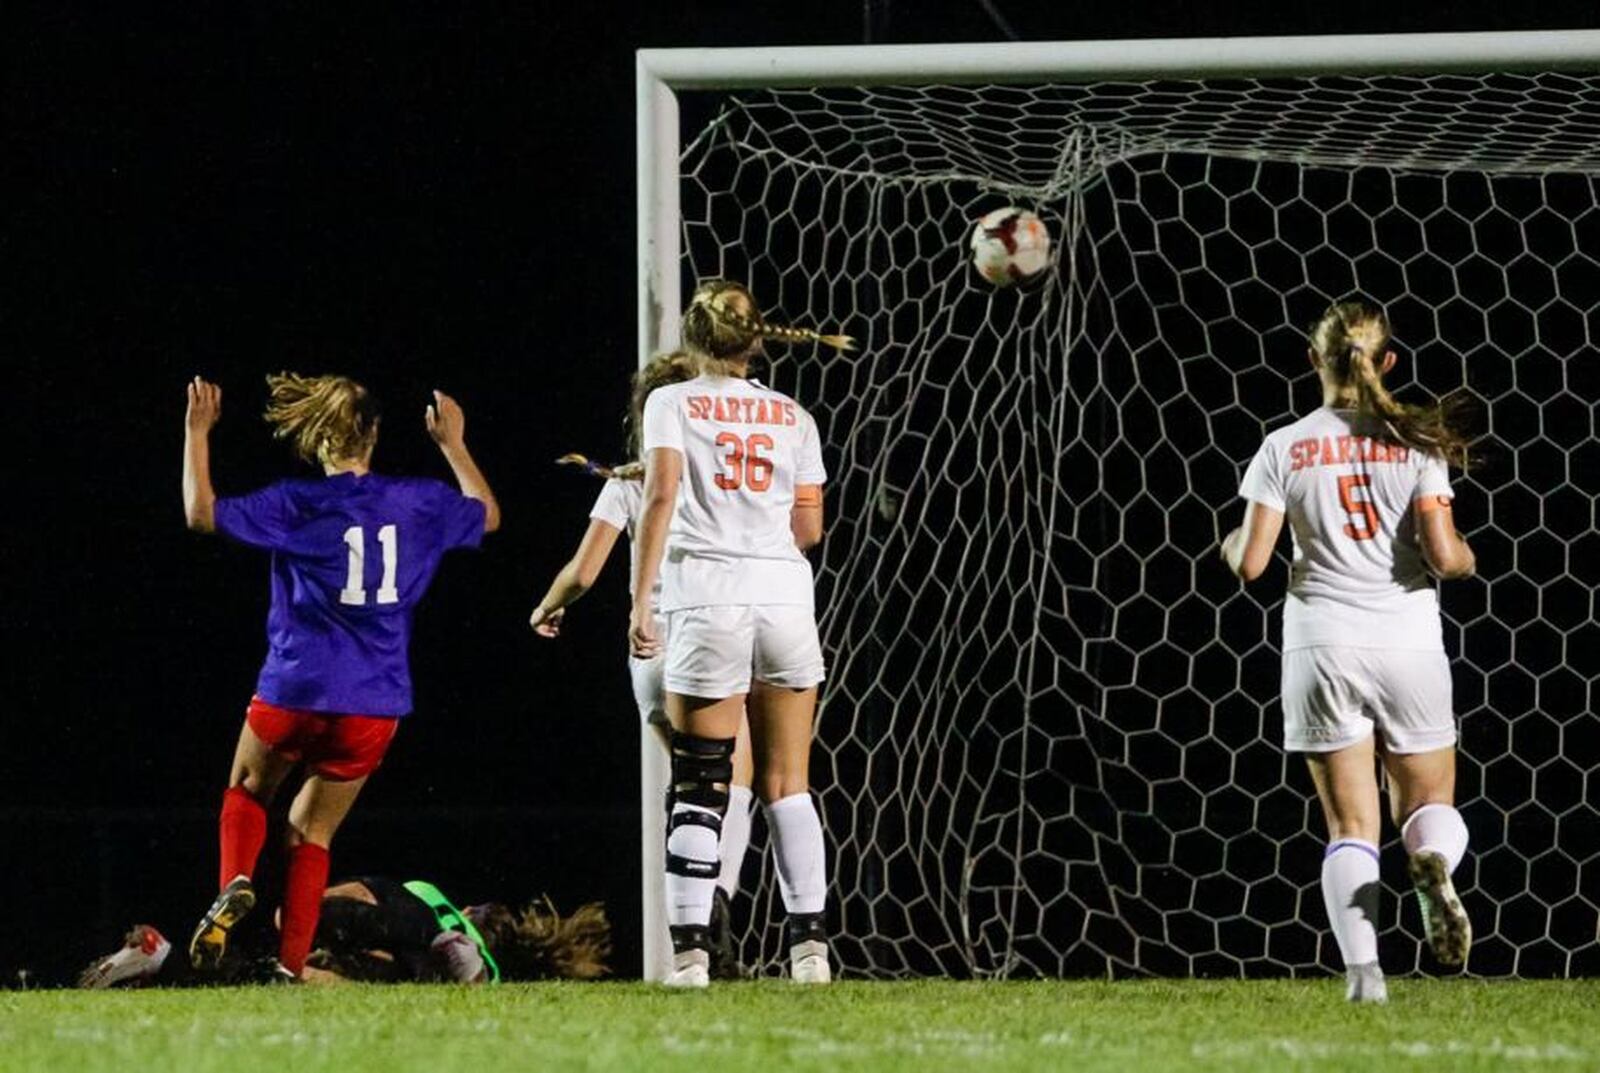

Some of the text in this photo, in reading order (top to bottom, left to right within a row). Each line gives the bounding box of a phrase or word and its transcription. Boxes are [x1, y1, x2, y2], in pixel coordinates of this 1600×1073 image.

[686, 396, 797, 427] SPARTANS
[714, 431, 775, 493] 36
[1338, 474, 1379, 541] 5
[339, 524, 399, 605] 11
